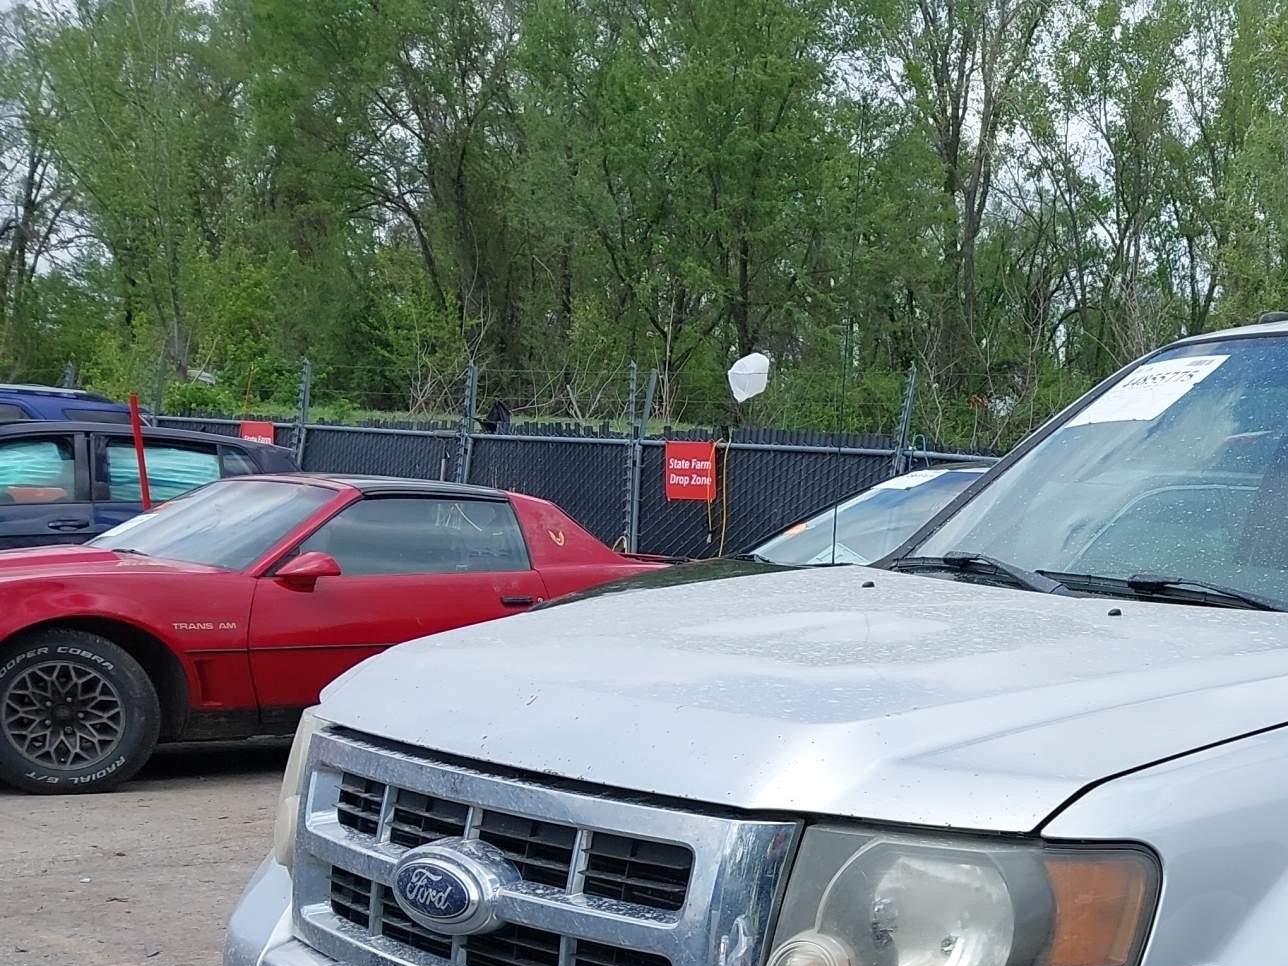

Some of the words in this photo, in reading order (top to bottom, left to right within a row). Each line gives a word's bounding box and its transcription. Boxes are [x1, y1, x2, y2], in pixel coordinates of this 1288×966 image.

[669, 458, 690, 469] State
[691, 459, 712, 470] Farm
[669, 474, 690, 487] Drop
[691, 475, 712, 485] Zone
[172, 622, 214, 630] TRANS
[218, 622, 237, 630] AM
[57, 646, 114, 670] COBRA
[68, 756, 126, 784] RADIAL
[406, 868, 453, 910] Ford
